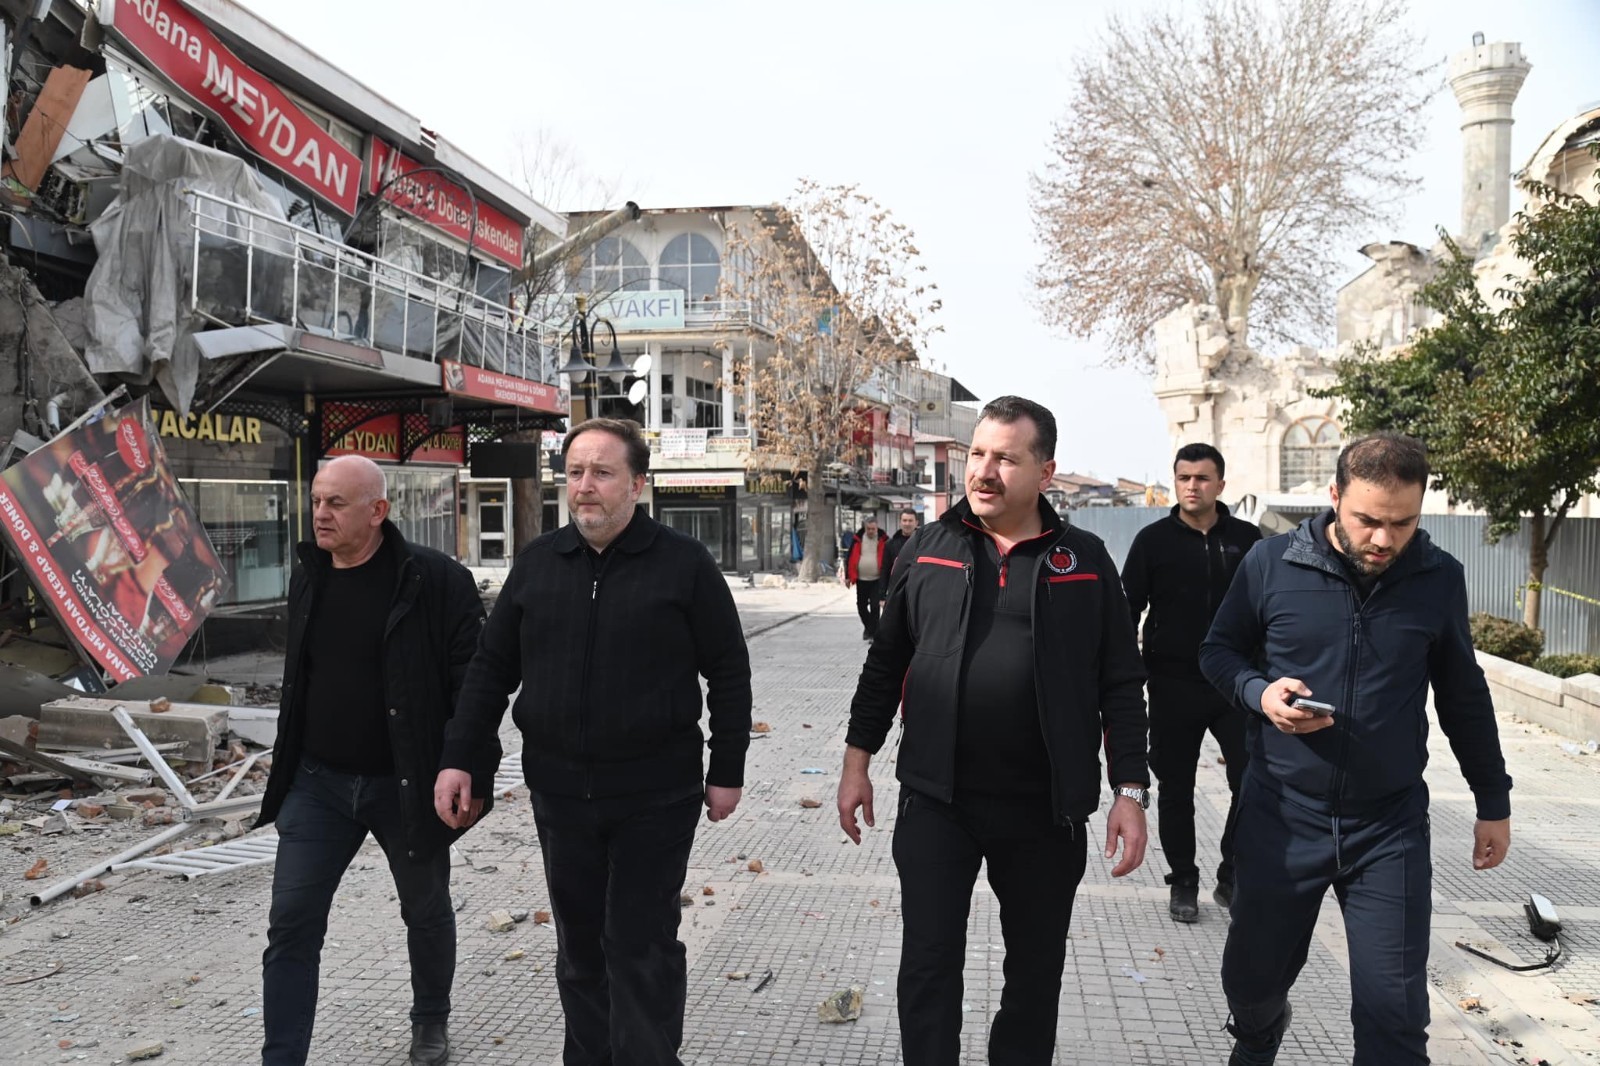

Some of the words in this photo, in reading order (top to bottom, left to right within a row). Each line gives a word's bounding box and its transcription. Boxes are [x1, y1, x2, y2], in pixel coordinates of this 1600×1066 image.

[202, 49, 348, 197] MEYDAN
[610, 297, 678, 318] VAKFI
[0, 492, 31, 541] DÖNER
[29, 541, 40, 553] &
[36, 556, 67, 599] KEBAP
[72, 574, 107, 628] YANINDA
[64, 598, 106, 650] MEYDAN
[107, 602, 158, 664] UNUTMA!
[105, 649, 136, 680] DANA
